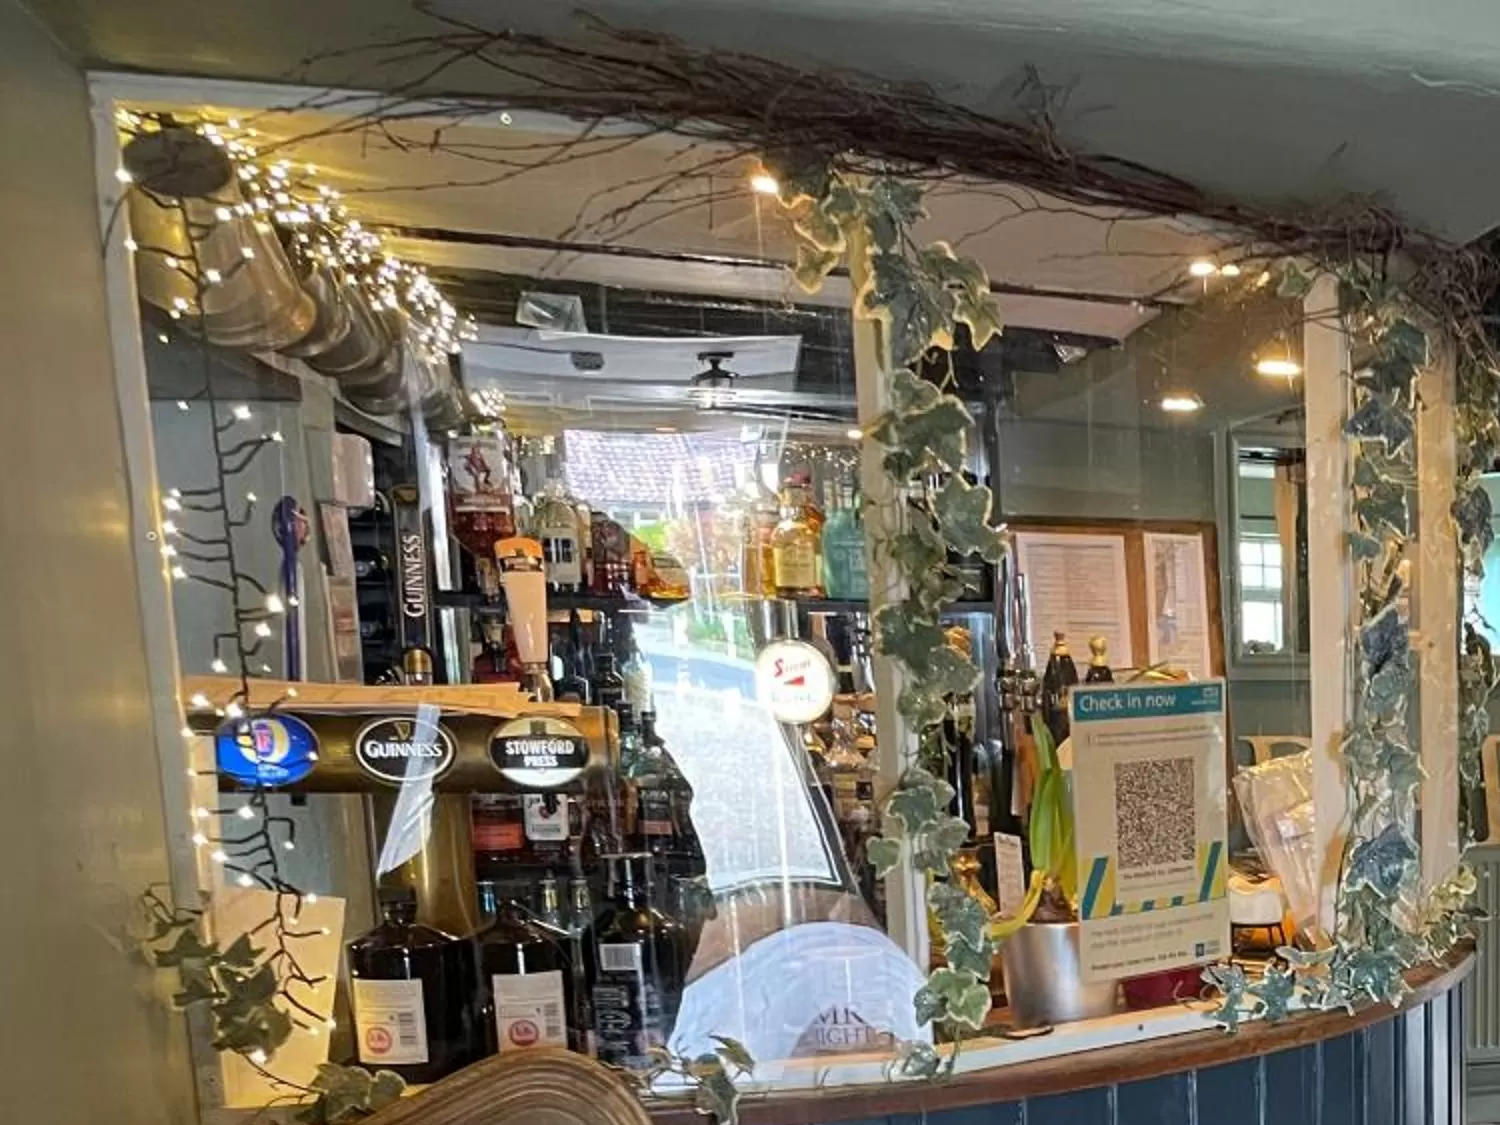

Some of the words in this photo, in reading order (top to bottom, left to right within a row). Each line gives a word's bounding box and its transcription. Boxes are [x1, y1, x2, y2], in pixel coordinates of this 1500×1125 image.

[402, 535, 425, 617] GUINNESS
[1079, 693, 1122, 712] Check
[1127, 693, 1142, 708] in
[1145, 694, 1176, 707] now
[365, 740, 443, 758] GUINNESS
[505, 740, 575, 755] STOWFORD
